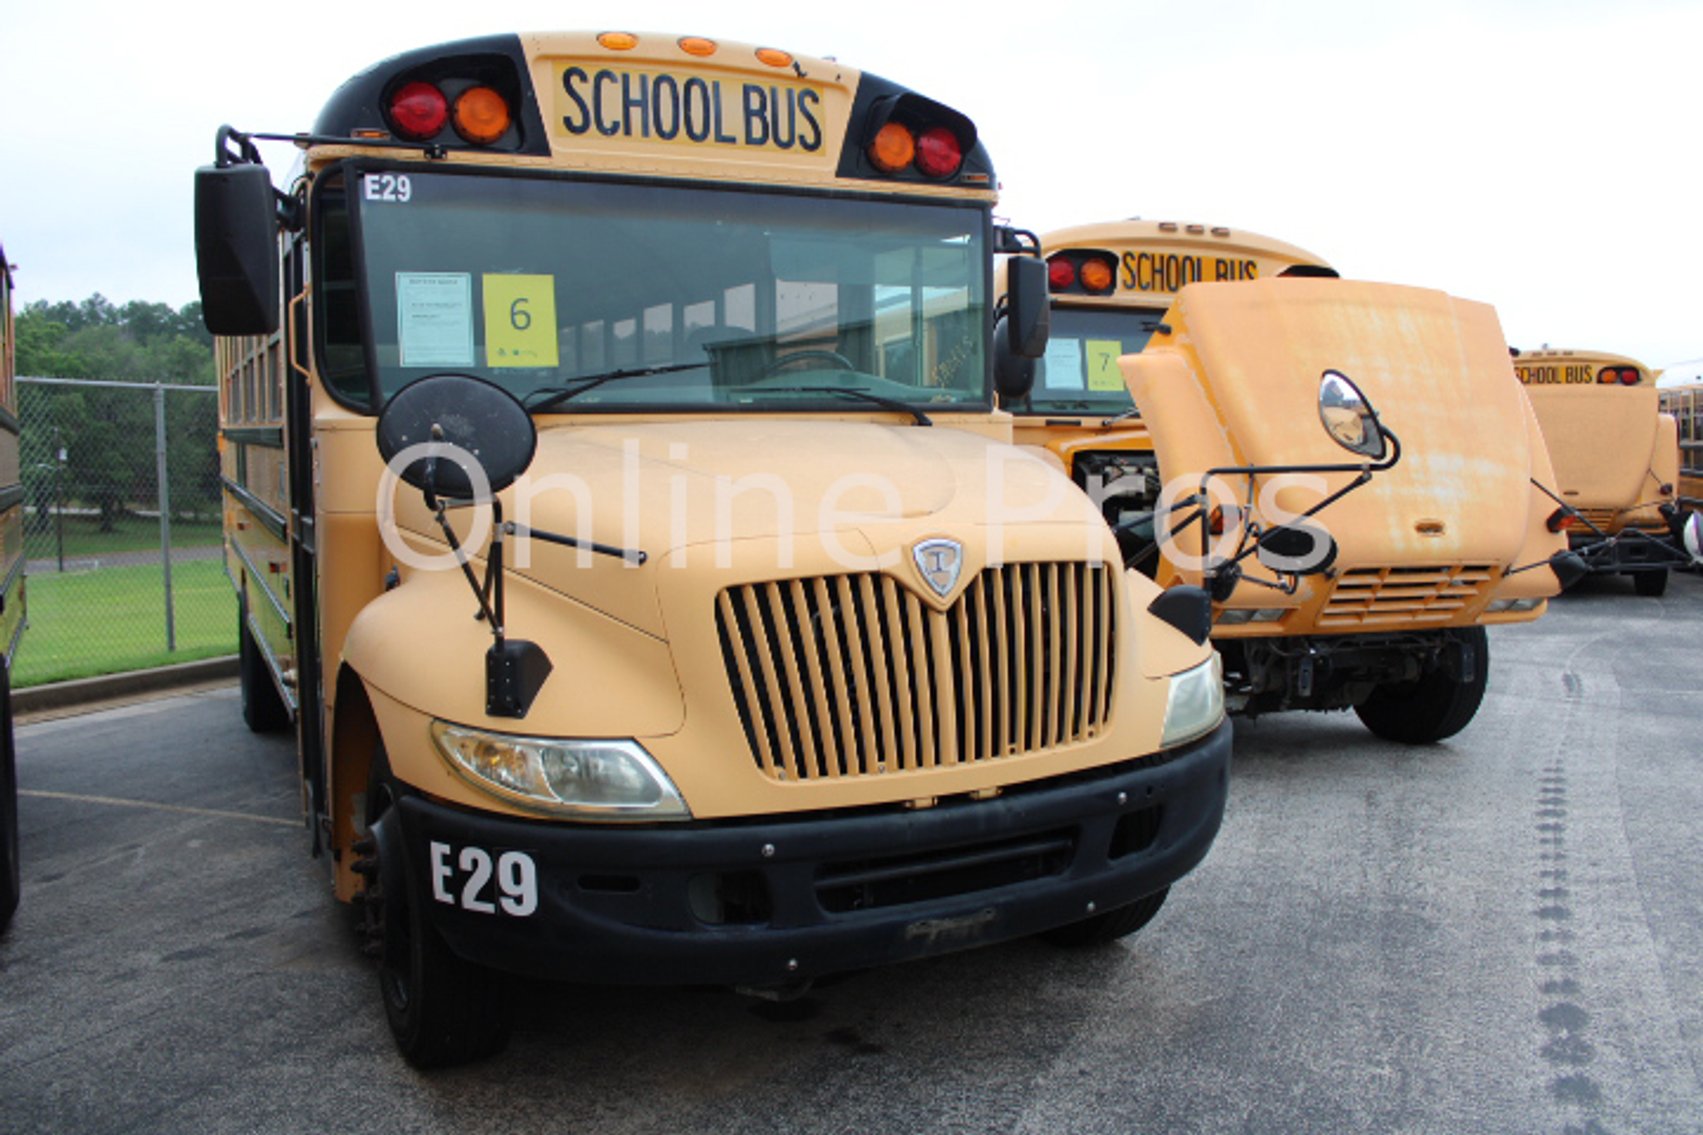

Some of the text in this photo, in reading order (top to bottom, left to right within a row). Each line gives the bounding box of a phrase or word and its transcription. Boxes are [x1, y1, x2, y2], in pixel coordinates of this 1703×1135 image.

[562, 66, 822, 152] SCHOOL BUS
[364, 173, 412, 202] E29
[511, 298, 531, 330] 6
[1098, 352, 1110, 372] 7
[1565, 365, 1593, 384] BUS
[430, 841, 538, 917] E29
